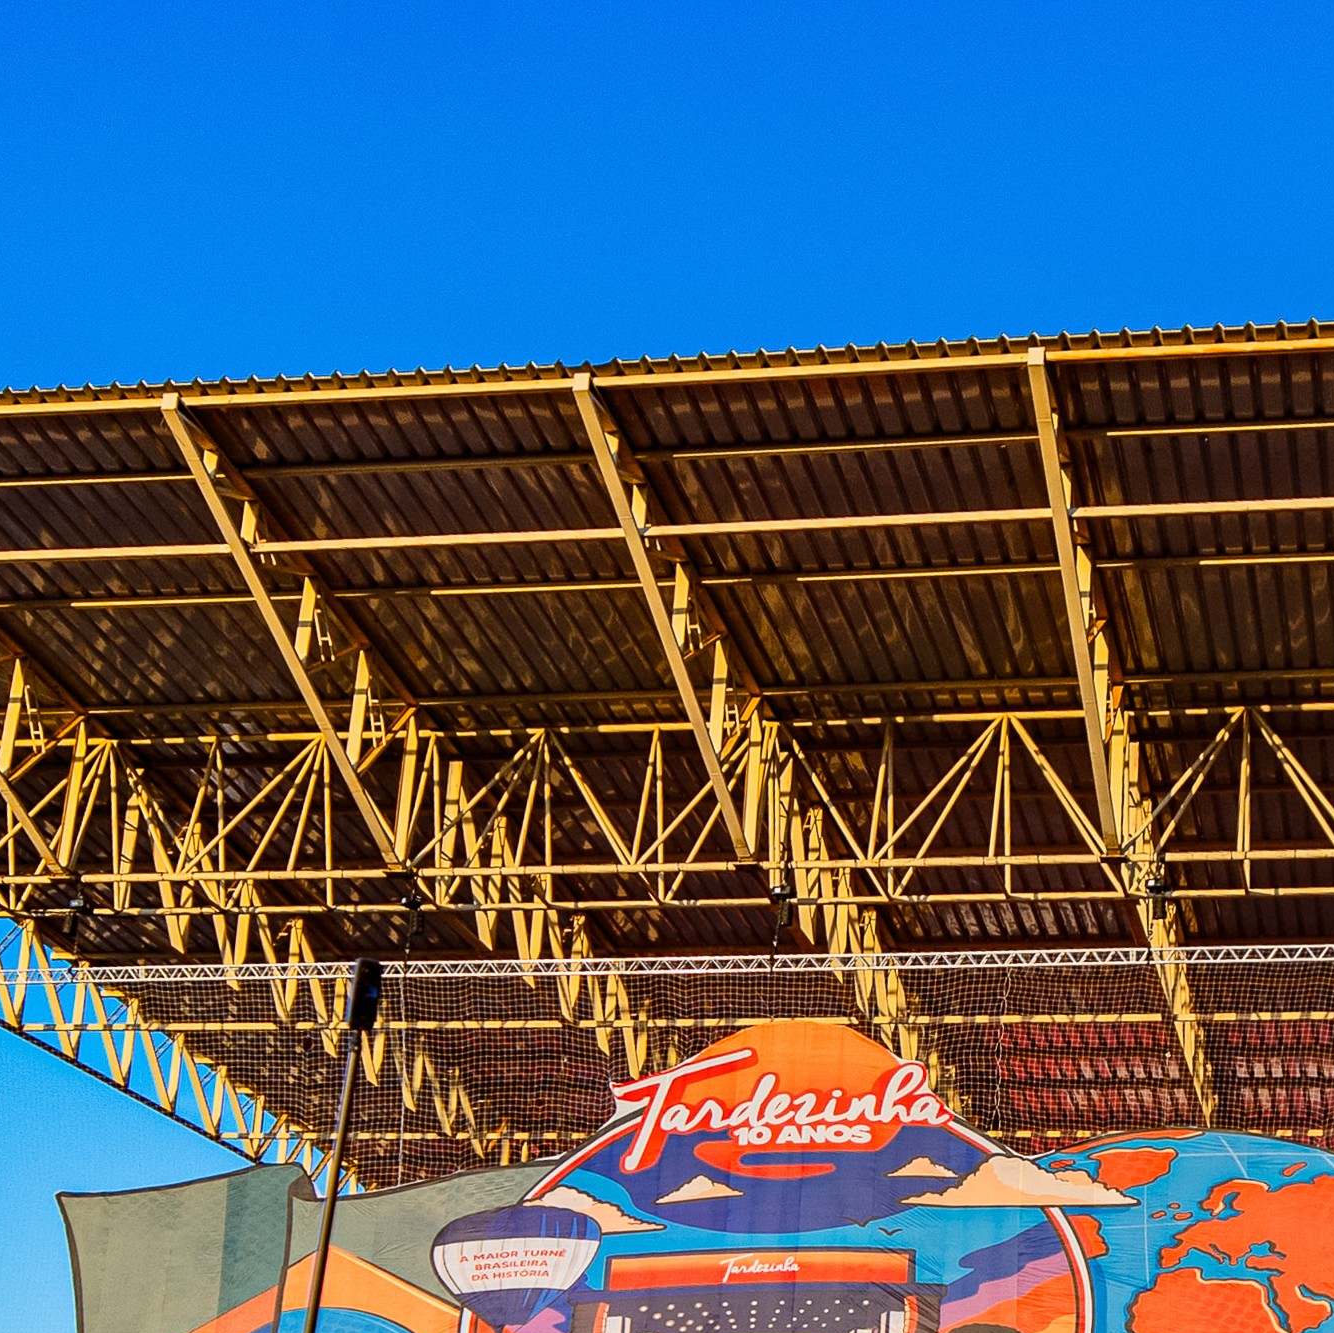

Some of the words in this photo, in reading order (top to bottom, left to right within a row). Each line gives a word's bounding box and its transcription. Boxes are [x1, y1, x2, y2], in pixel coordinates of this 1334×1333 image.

[614, 1049, 950, 1170] Tardezinha
[733, 1128, 771, 1146] 10
[776, 1125, 872, 1143] ANOS
[473, 1250, 519, 1260] MAIOR
[474, 1260, 548, 1271] BRASILEIRA
[719, 1253, 800, 1283] Tardezinha
[472, 1273, 490, 1282] DA
[492, 1269, 550, 1280] HISTÓRIA
